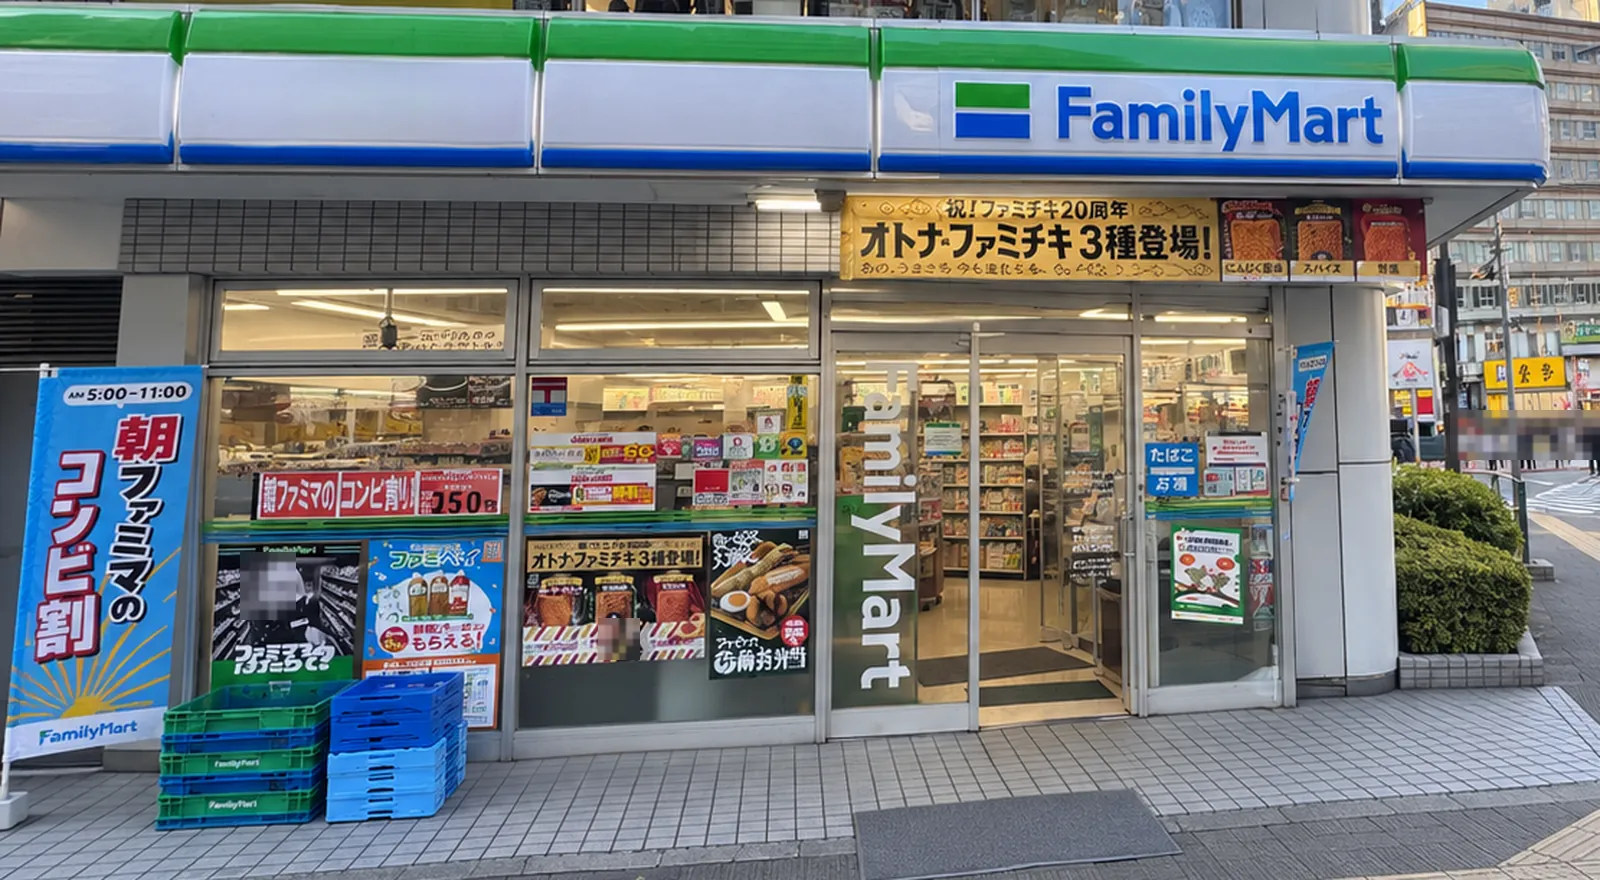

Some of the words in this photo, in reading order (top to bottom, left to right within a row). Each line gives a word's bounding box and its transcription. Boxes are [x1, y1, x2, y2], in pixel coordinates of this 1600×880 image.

[1057, 86, 1384, 152] FamilyMart
[87, 385, 187, 402] 5:00-11:00
[34, 450, 105, 664] コンビ割
[111, 413, 182, 624] 朝ファミマの
[851, 362, 919, 690] FamilyMart
[38, 719, 138, 746] FamilyMart
